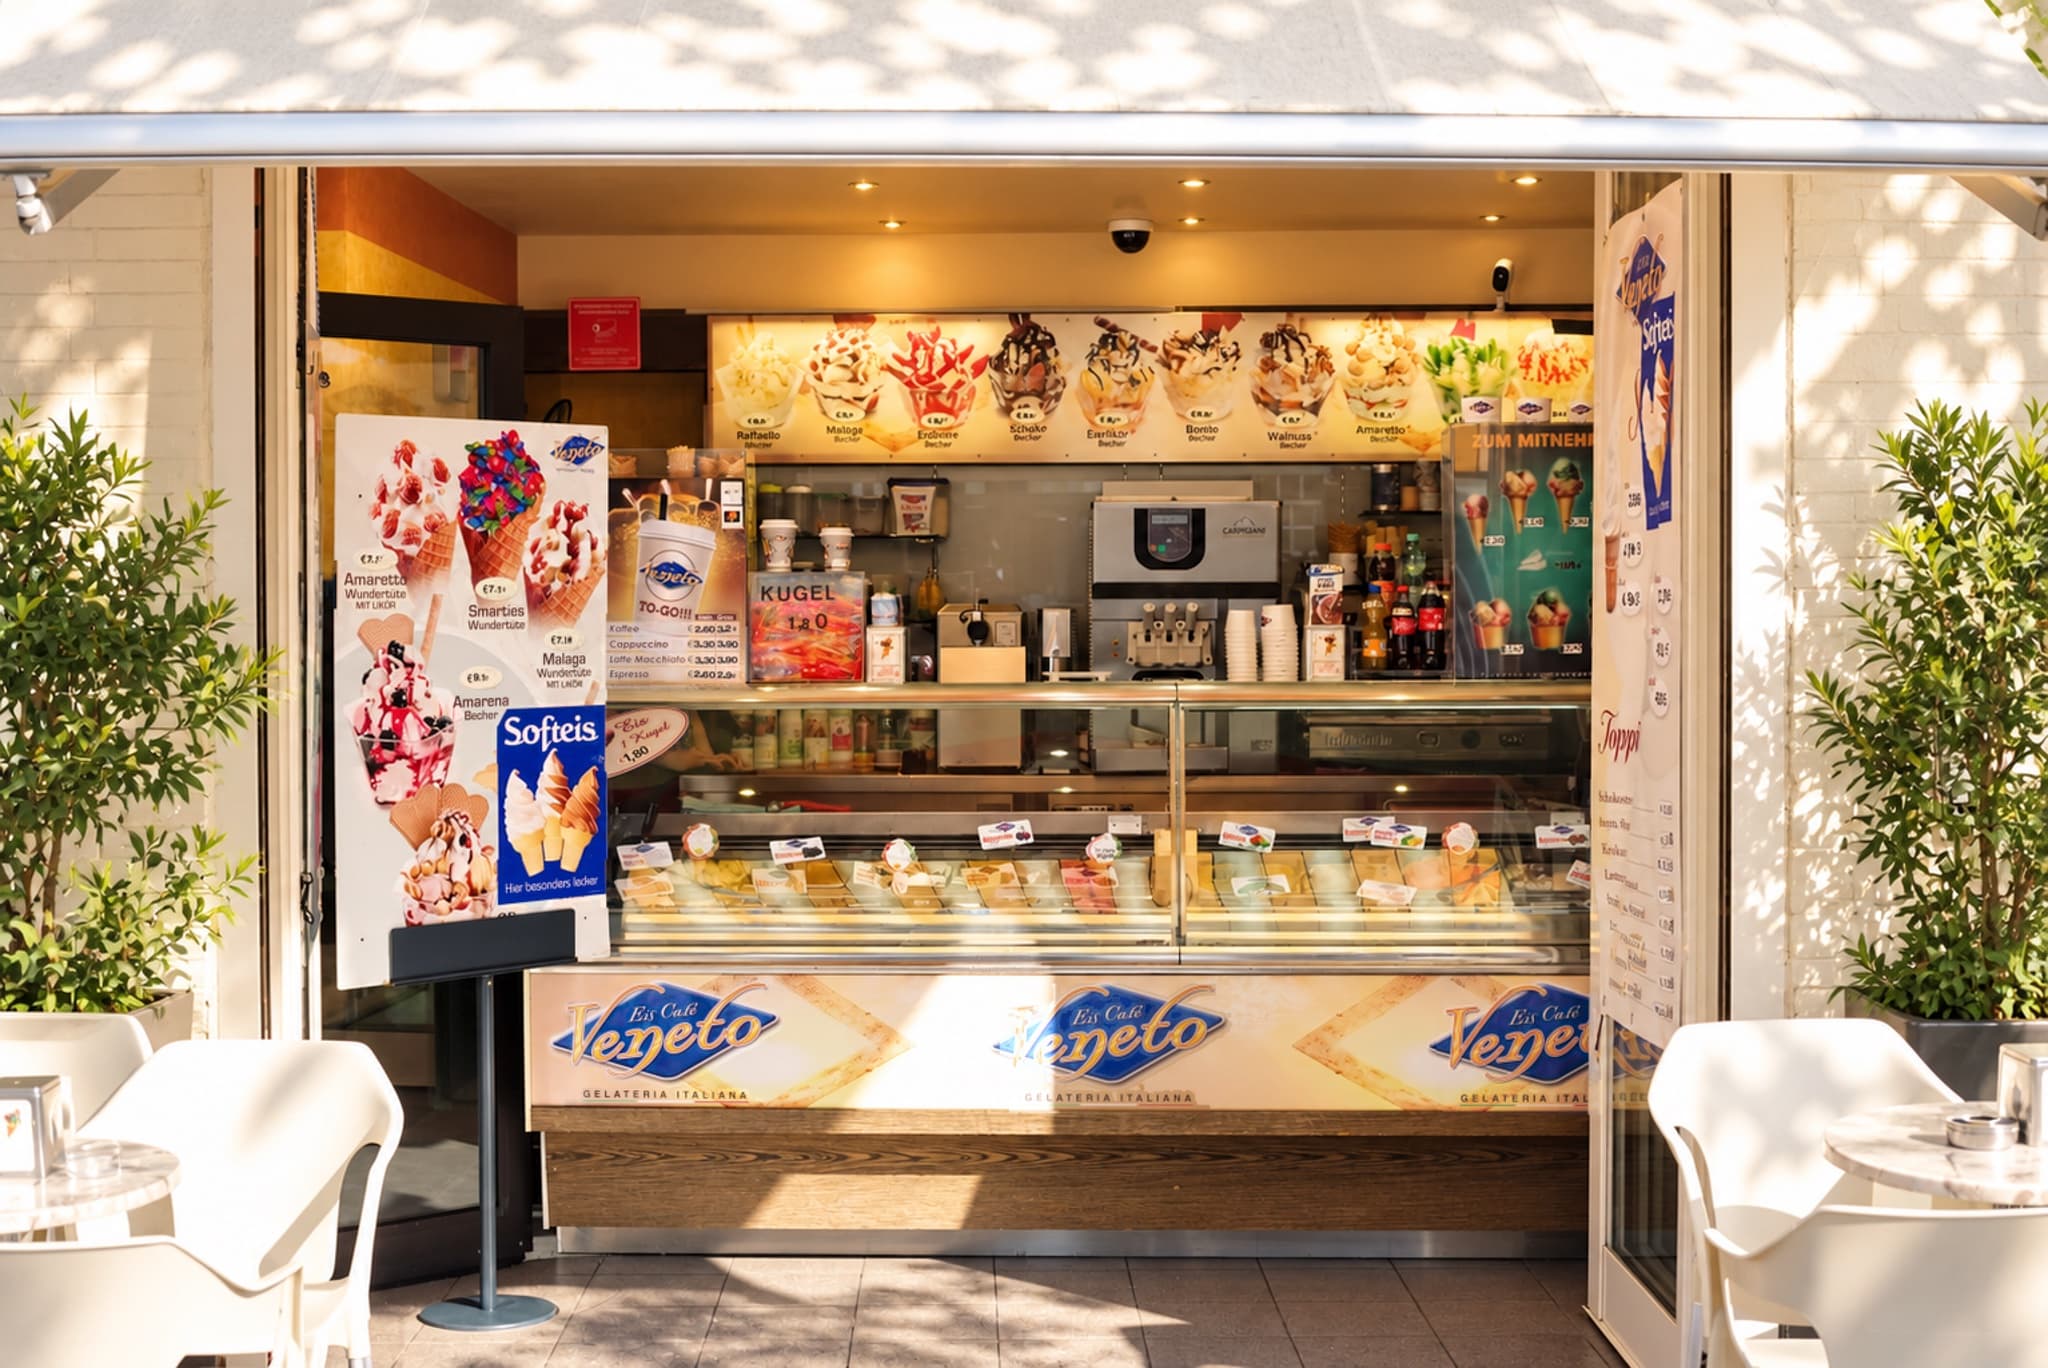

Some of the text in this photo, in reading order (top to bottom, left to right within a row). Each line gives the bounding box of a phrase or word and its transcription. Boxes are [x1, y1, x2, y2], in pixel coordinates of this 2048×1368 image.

[1267, 432, 1312, 441] Walnuss
[1356, 425, 1406, 434] Amaretto
[1472, 433, 1512, 448] ZUM
[344, 572, 407, 586] Amaretto
[344, 589, 407, 599] Wundertüte
[761, 585, 835, 601] KUGEL
[468, 604, 525, 618] Smarties
[609, 640, 669, 650] Cappuccino
[542, 653, 586, 667] Malaga
[609, 670, 649, 679] Espresso
[453, 695, 509, 707] Amarena
[464, 711, 499, 720] Becher
[614, 718, 649, 732] Eis
[504, 715, 599, 752] Softeis
[505, 883, 522, 894] Hier
[525, 879, 571, 892] besonders
[628, 1002, 698, 1023] Eis Café
[1072, 1005, 1143, 1025] Eis Café
[1509, 1006, 1582, 1025] Eis Café
[568, 983, 767, 1078] Veneto
[583, 1090, 747, 1099] GELATERIA ITALIANA
[1025, 1093, 1192, 1102] GELATERIA ITALIANA
[1460, 1094, 1546, 1103] GELATERIA
